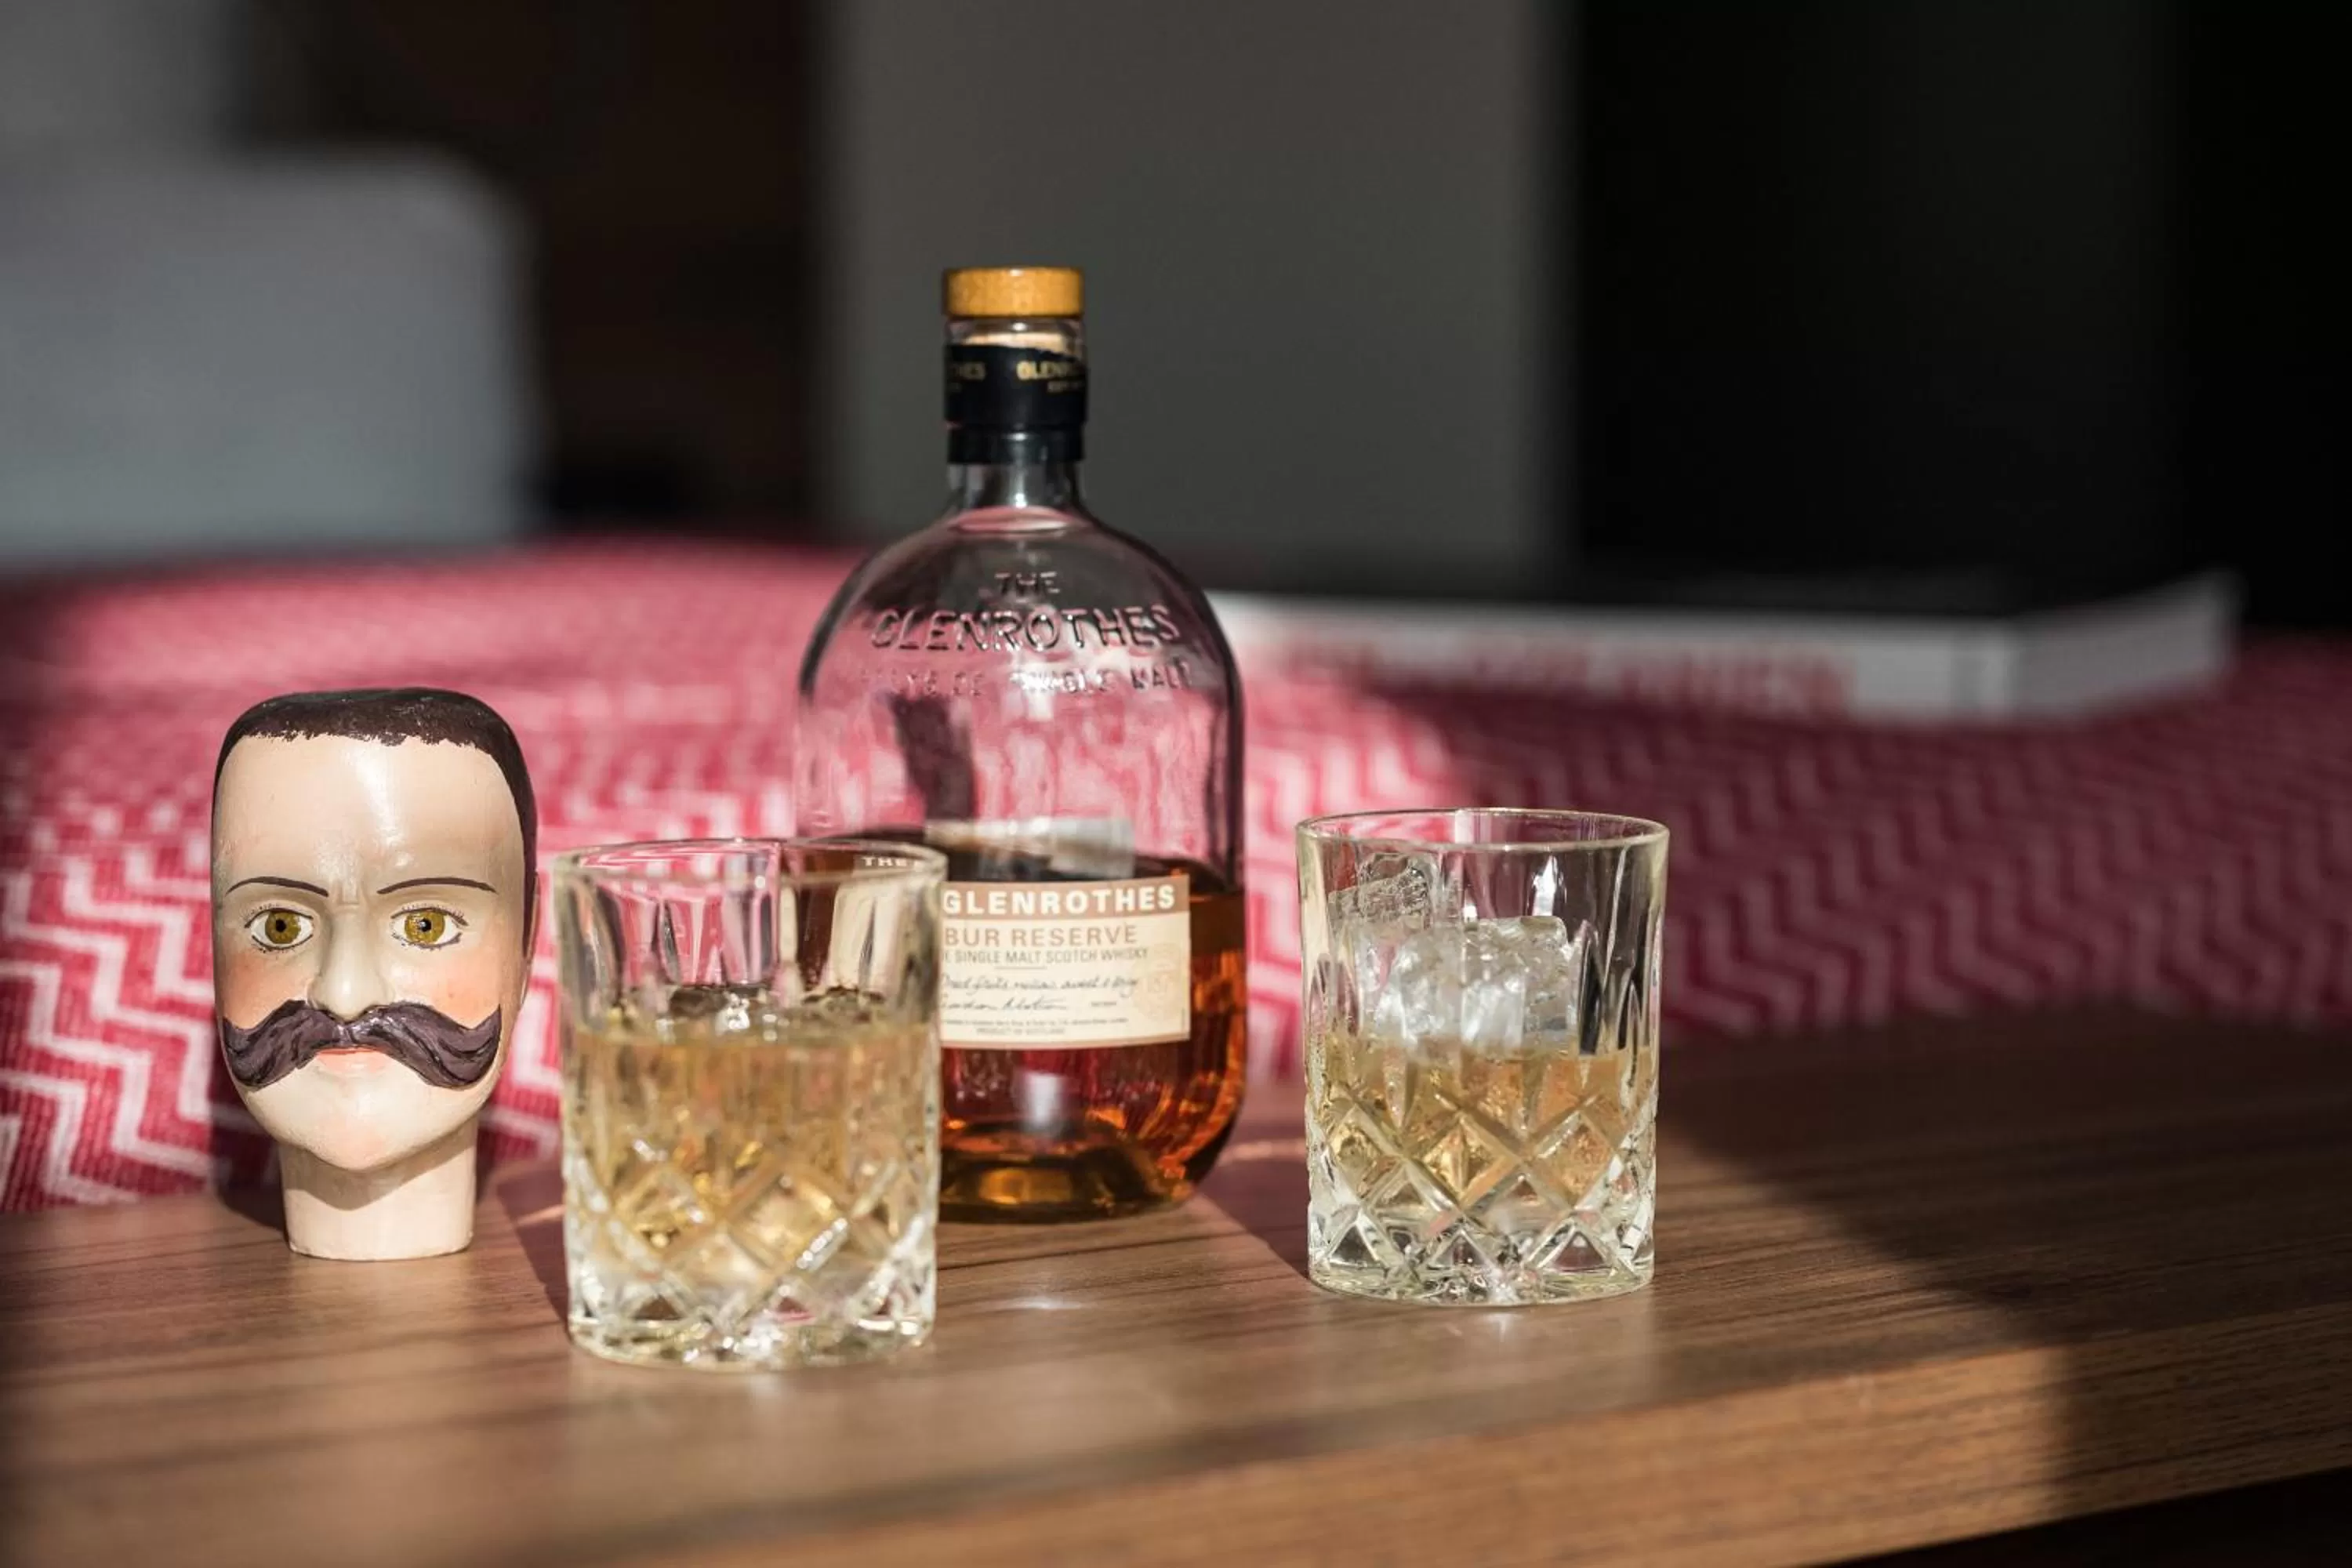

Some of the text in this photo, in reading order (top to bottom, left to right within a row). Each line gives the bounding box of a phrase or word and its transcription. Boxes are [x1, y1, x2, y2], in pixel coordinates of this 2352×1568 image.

[993, 571, 1062, 596] THE
[870, 603, 1181, 653] GLENROTHES
[861, 856, 907, 867] THE
[942, 884, 1176, 915] GLENROTHES
[1011, 924, 1137, 947] RESERVE
[954, 949, 1000, 964] SINGLE
[1005, 949, 1042, 964] MALT
[1046, 948, 1098, 964] SCOTCH
[1101, 946, 1149, 961] WHISKY
